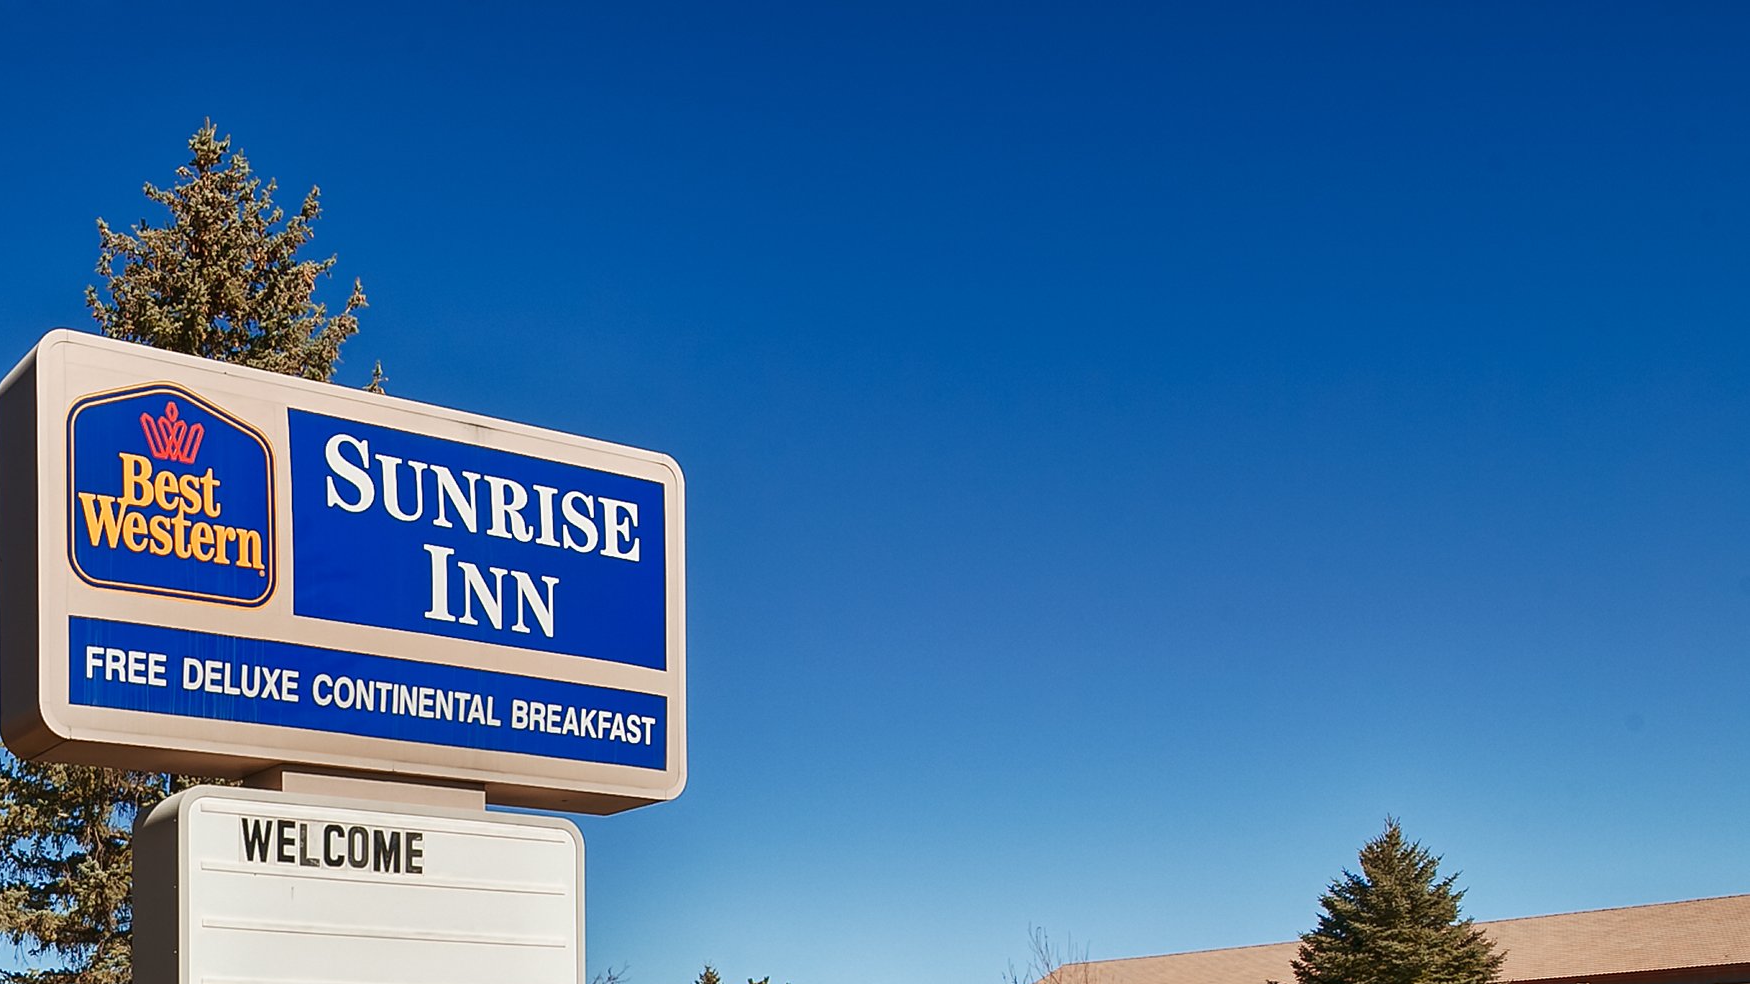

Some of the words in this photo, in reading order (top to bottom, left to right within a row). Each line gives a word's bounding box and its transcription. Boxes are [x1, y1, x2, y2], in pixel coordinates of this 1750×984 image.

[117, 451, 221, 518] Best
[325, 433, 641, 563] SUNRISE
[77, 490, 266, 572] Western
[423, 543, 561, 639] INN
[85, 645, 168, 688] FREE
[182, 656, 299, 703] DELUXE
[311, 672, 502, 729] CONTINENTAL
[510, 698, 656, 747] BREAKFAST
[240, 817, 424, 875] WELCOME
